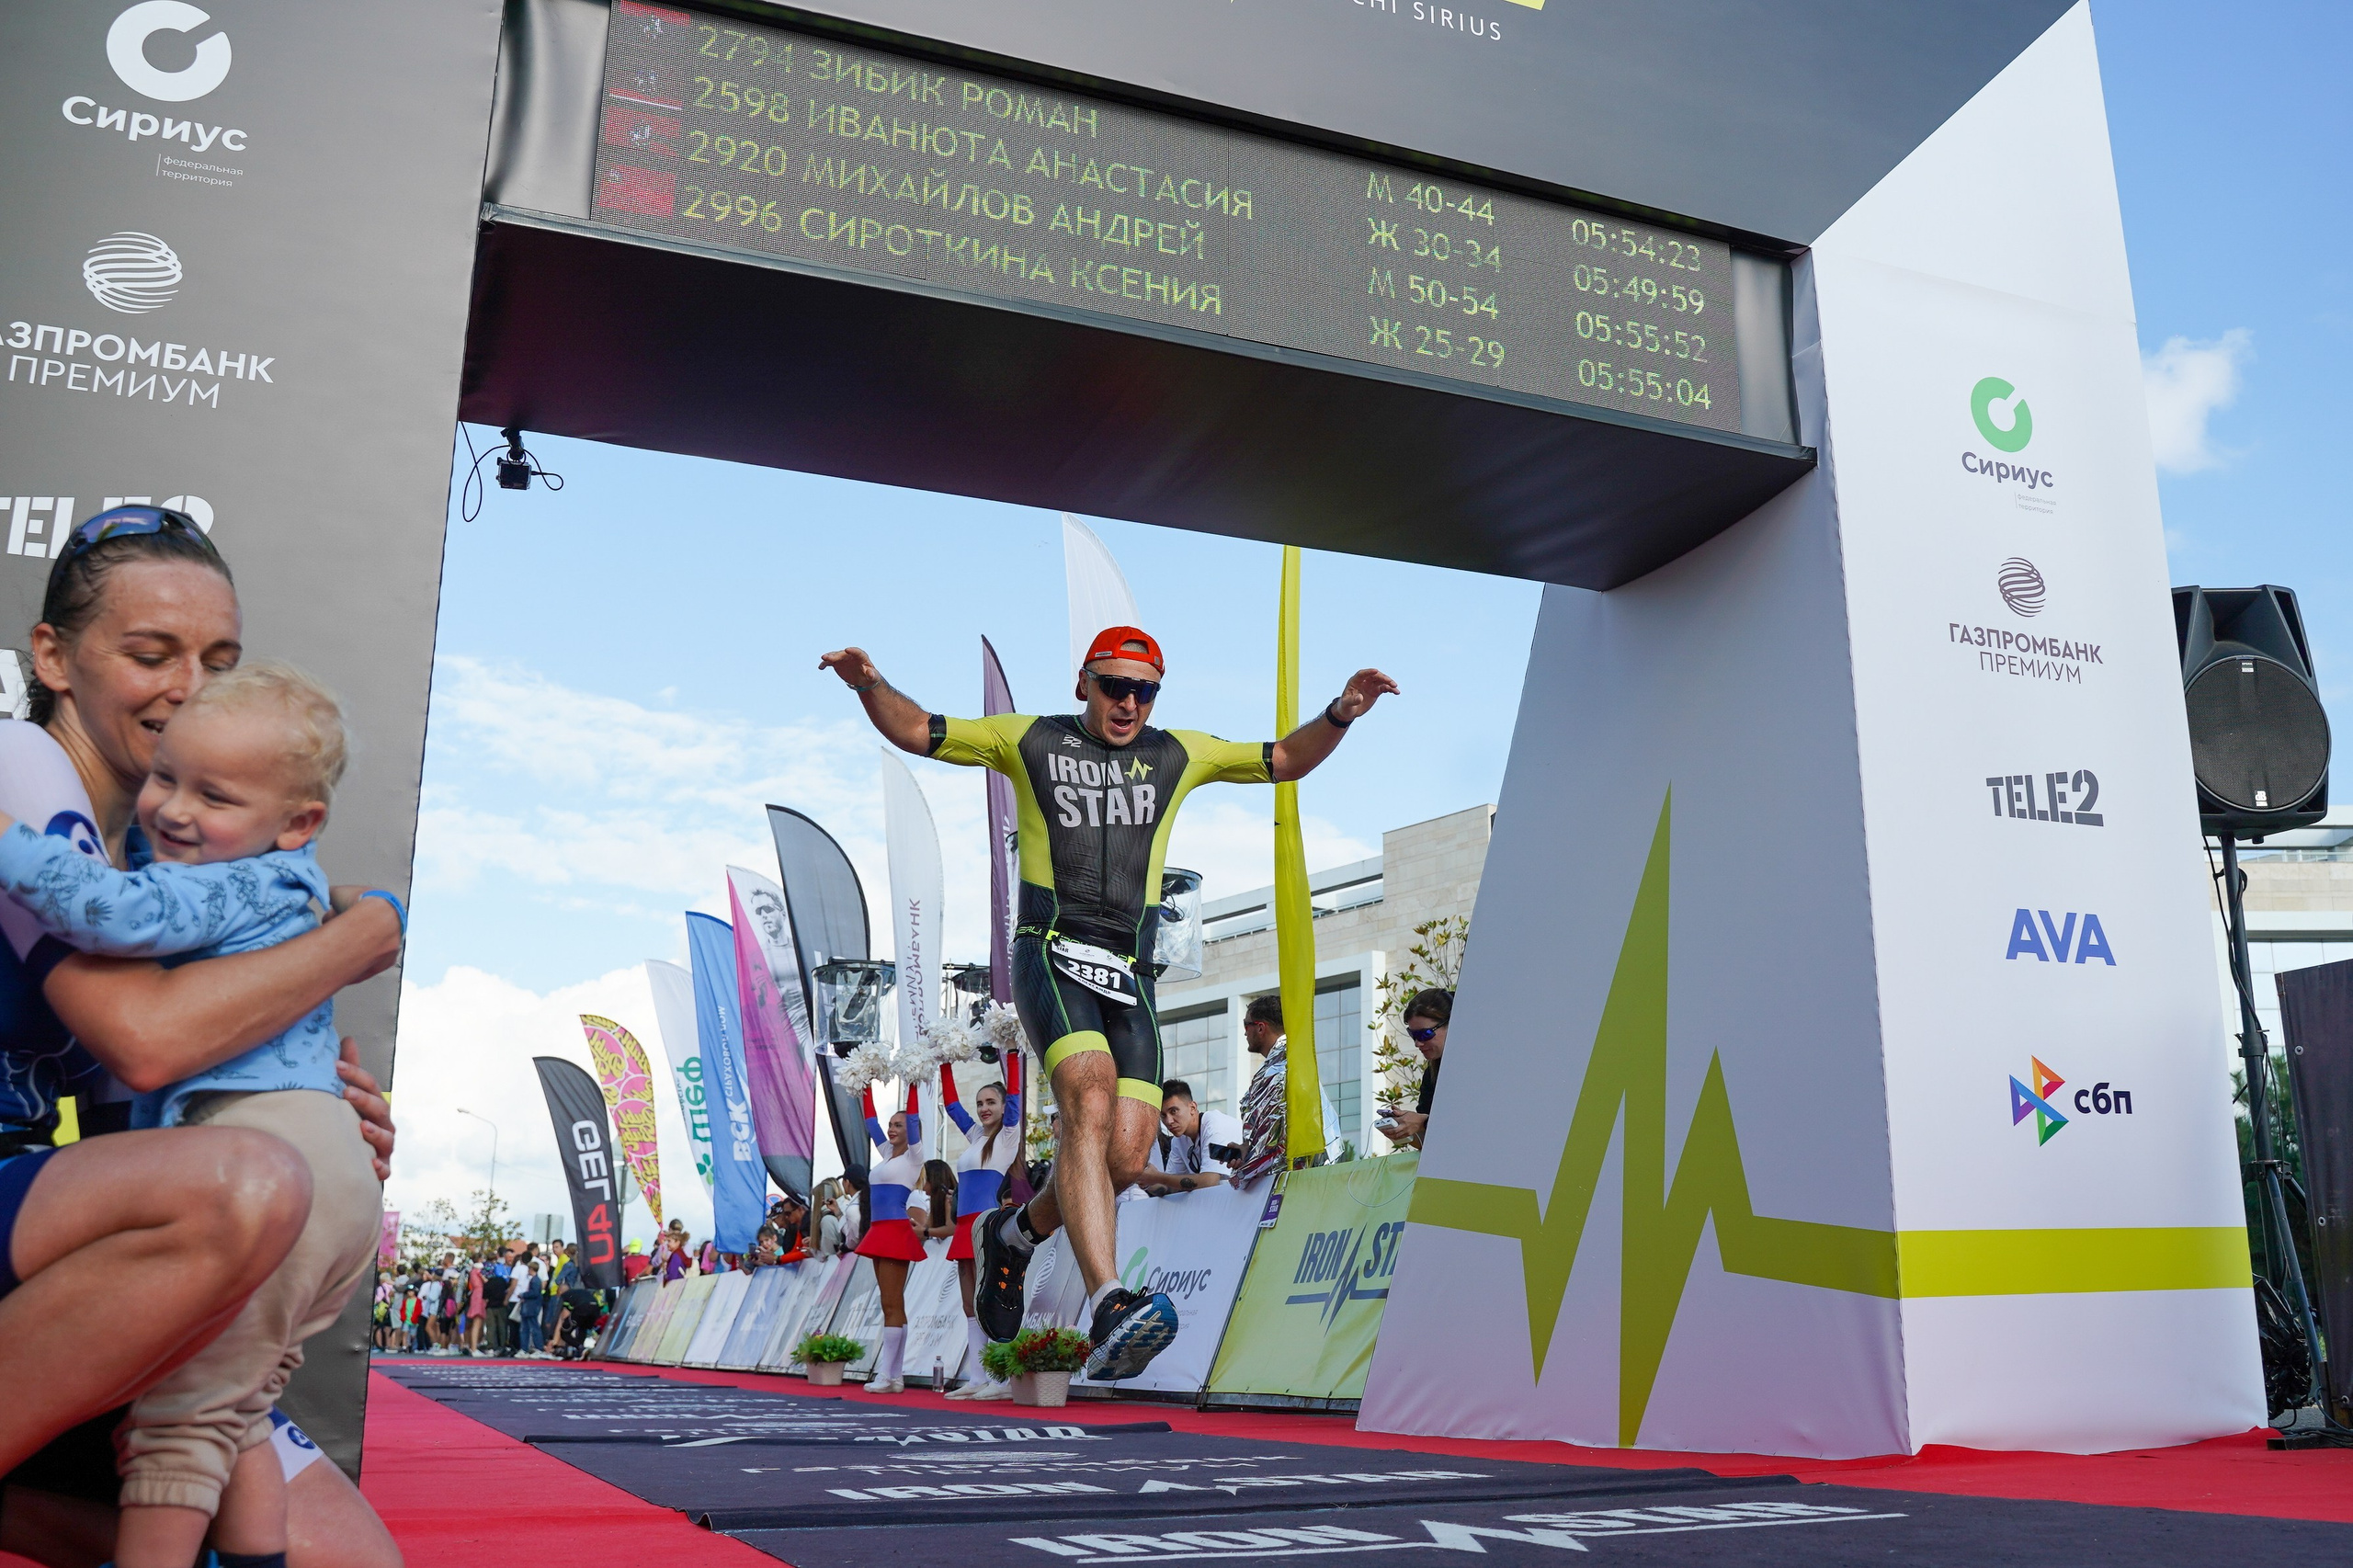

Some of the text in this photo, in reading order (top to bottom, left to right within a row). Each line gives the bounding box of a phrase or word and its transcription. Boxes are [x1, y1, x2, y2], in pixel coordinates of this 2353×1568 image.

[1413, 2, 1501, 40] SIRIUS
[62, 95, 249, 153] Сириус
[161, 167, 233, 187] территория
[164, 154, 244, 177] федеральная
[810, 49, 946, 106] ЗИБИК
[963, 81, 1097, 139] РОМАН
[1367, 172, 1394, 204] М
[1404, 182, 1496, 226] 40-44
[1572, 218, 1701, 273] 05:54:23
[694, 76, 1705, 317] 2598 ИВАНЮТА АНАСТАСИЯ Ж 30-34 05:49:59
[689, 131, 1708, 365] 2920 МИХАЙЛОВ АНДРЕЙ М 50-54 05:55:52
[682, 186, 1711, 411] 2996 СИРОТКИНА КСЕНИЯ Ж 25-29 05:55:04
[0, 321, 277, 384] ЗПРОМБАНК
[8, 355, 221, 410] ПРЕМИУМ
[1961, 450, 2054, 489] Сириус
[1949, 622, 2104, 665] ГАЗПРОМБАНК
[1979, 651, 2082, 684] ПРЕМИУМ
[1048, 752, 1124, 787] IRON
[1053, 784, 1156, 828] STAR
[1986, 769, 2104, 826] TELE2
[2006, 908, 2116, 965] AVA
[1067, 960, 1120, 990] 2381
[2073, 1082, 2132, 1115] сбп
[1293, 1221, 1406, 1284] IRON ST
[1147, 1266, 1211, 1300] Сириус
[824, 1471, 1495, 1500] IRON STAR
[1006, 1502, 1870, 1556] IRON STAR
